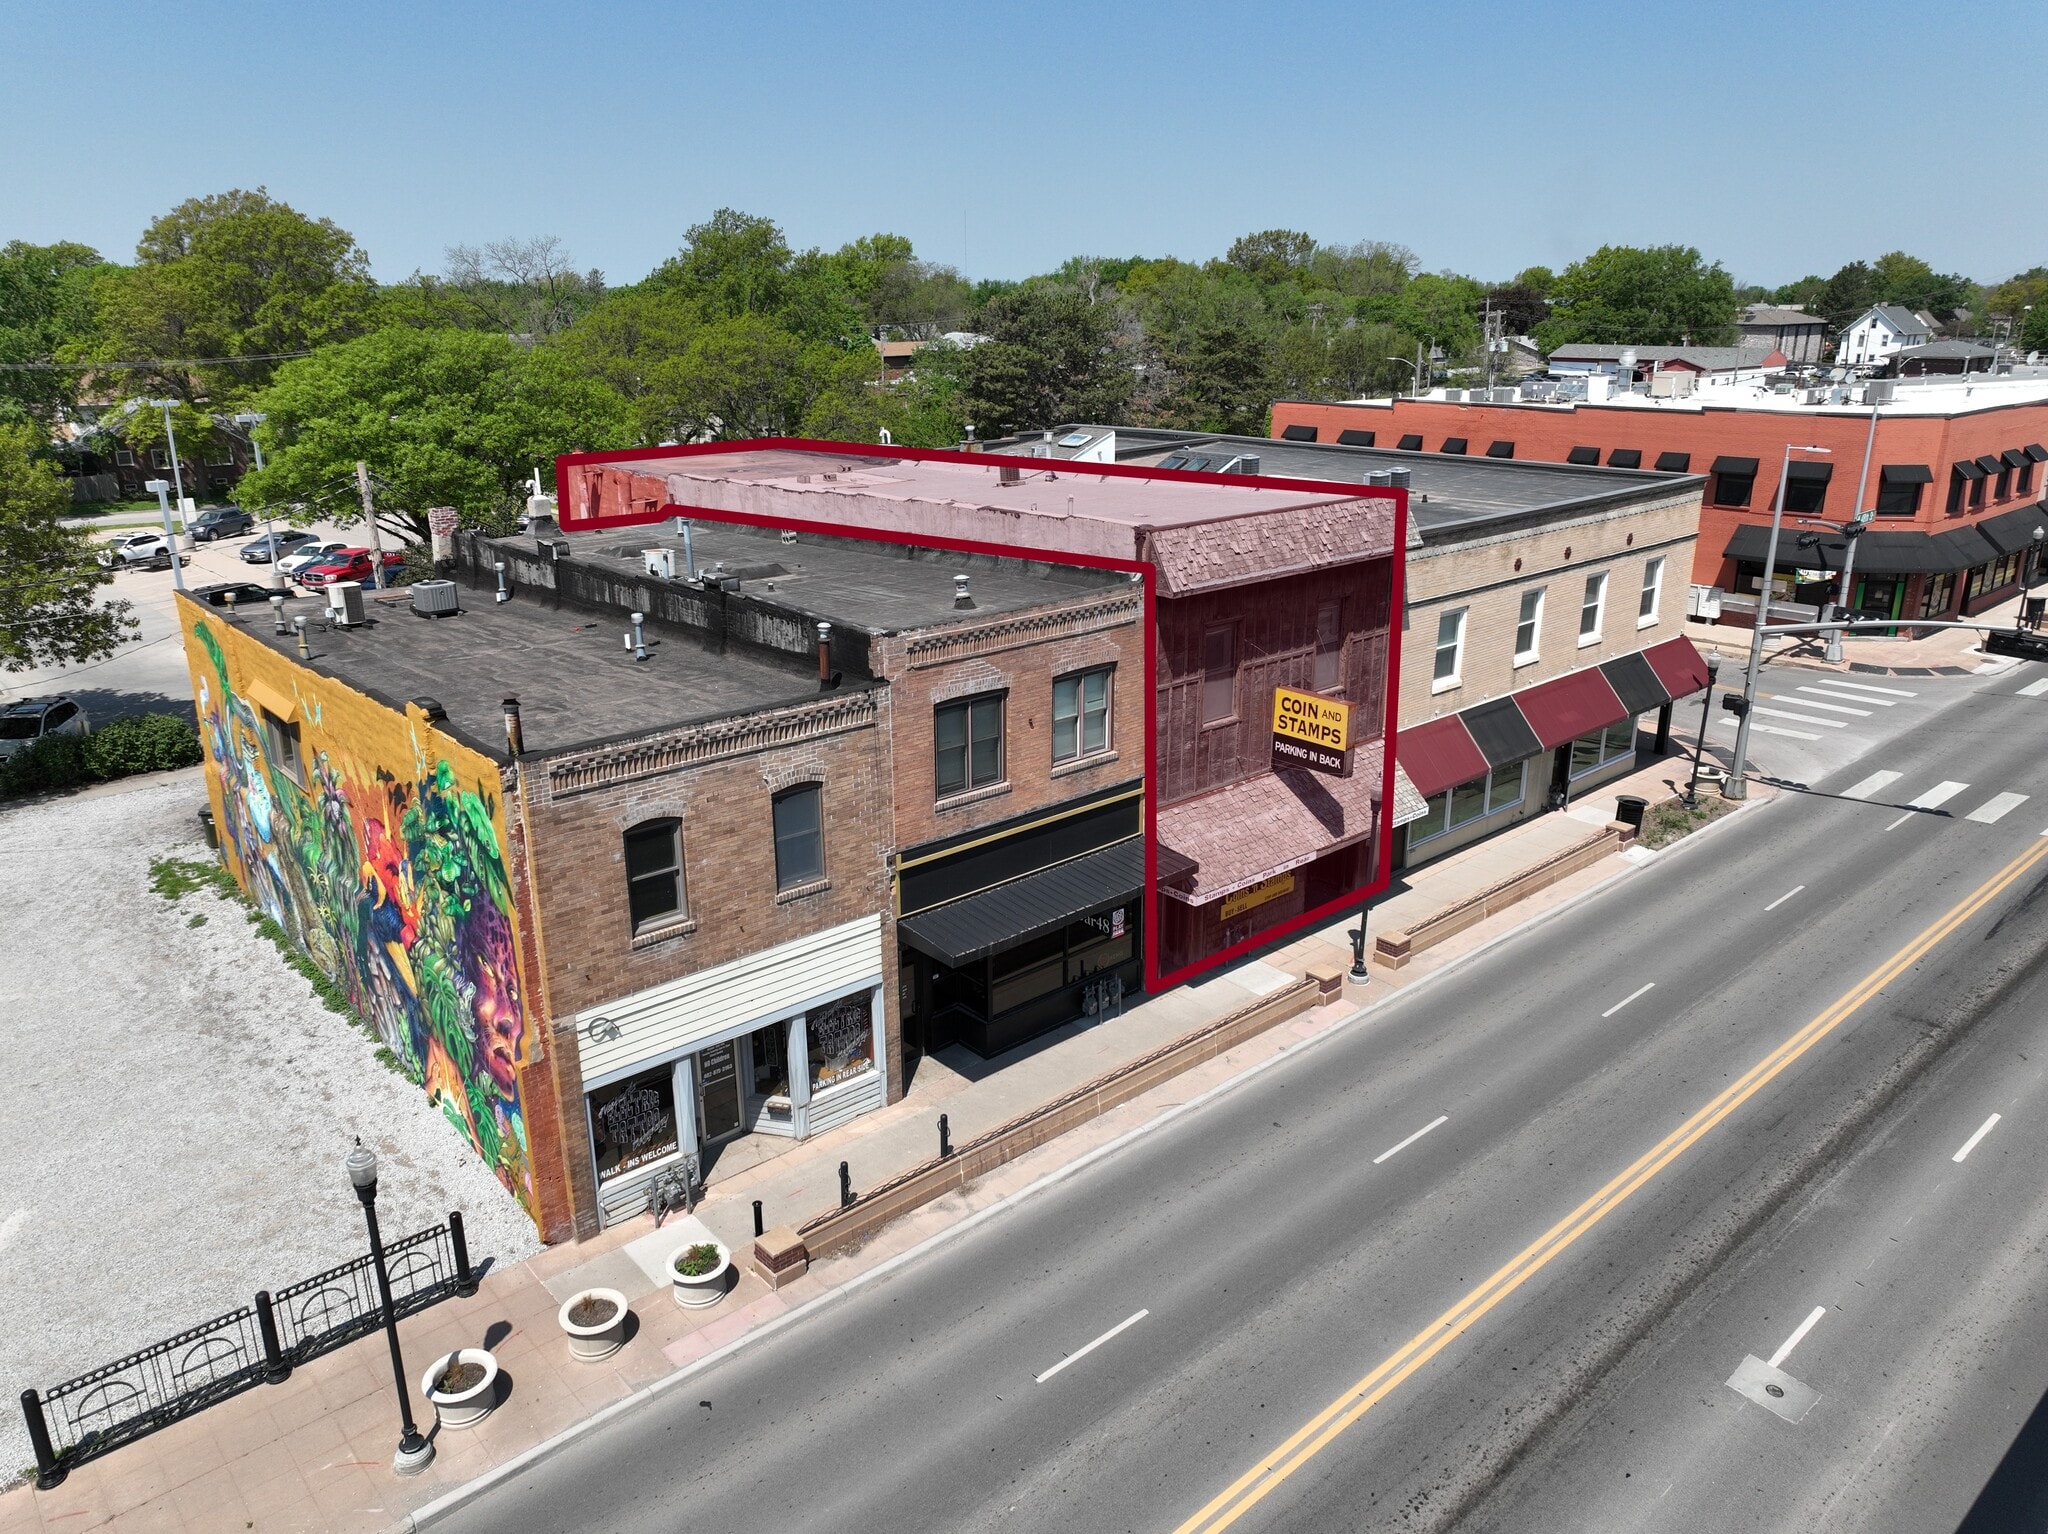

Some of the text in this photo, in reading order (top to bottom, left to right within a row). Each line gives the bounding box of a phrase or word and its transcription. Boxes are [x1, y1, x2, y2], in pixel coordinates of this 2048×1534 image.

[1282, 697, 1341, 722] COIN AND
[1278, 715, 1341, 744] STAMPS
[1275, 741, 1340, 769] PARKING IN BACK
[1204, 888, 1230, 901] Stamps
[1237, 878, 1255, 888] Coins
[1263, 868, 1276, 878] Park
[1296, 856, 1310, 865] Rear
[1080, 916, 1110, 934] ar48
[812, 1075, 836, 1091] PARKING
[836, 1071, 842, 1081] IN
[843, 1066, 856, 1077] REAR
[600, 1164, 622, 1180] WALK
[627, 1157, 640, 1169] INS
[641, 1141, 678, 1162] WELCOME
